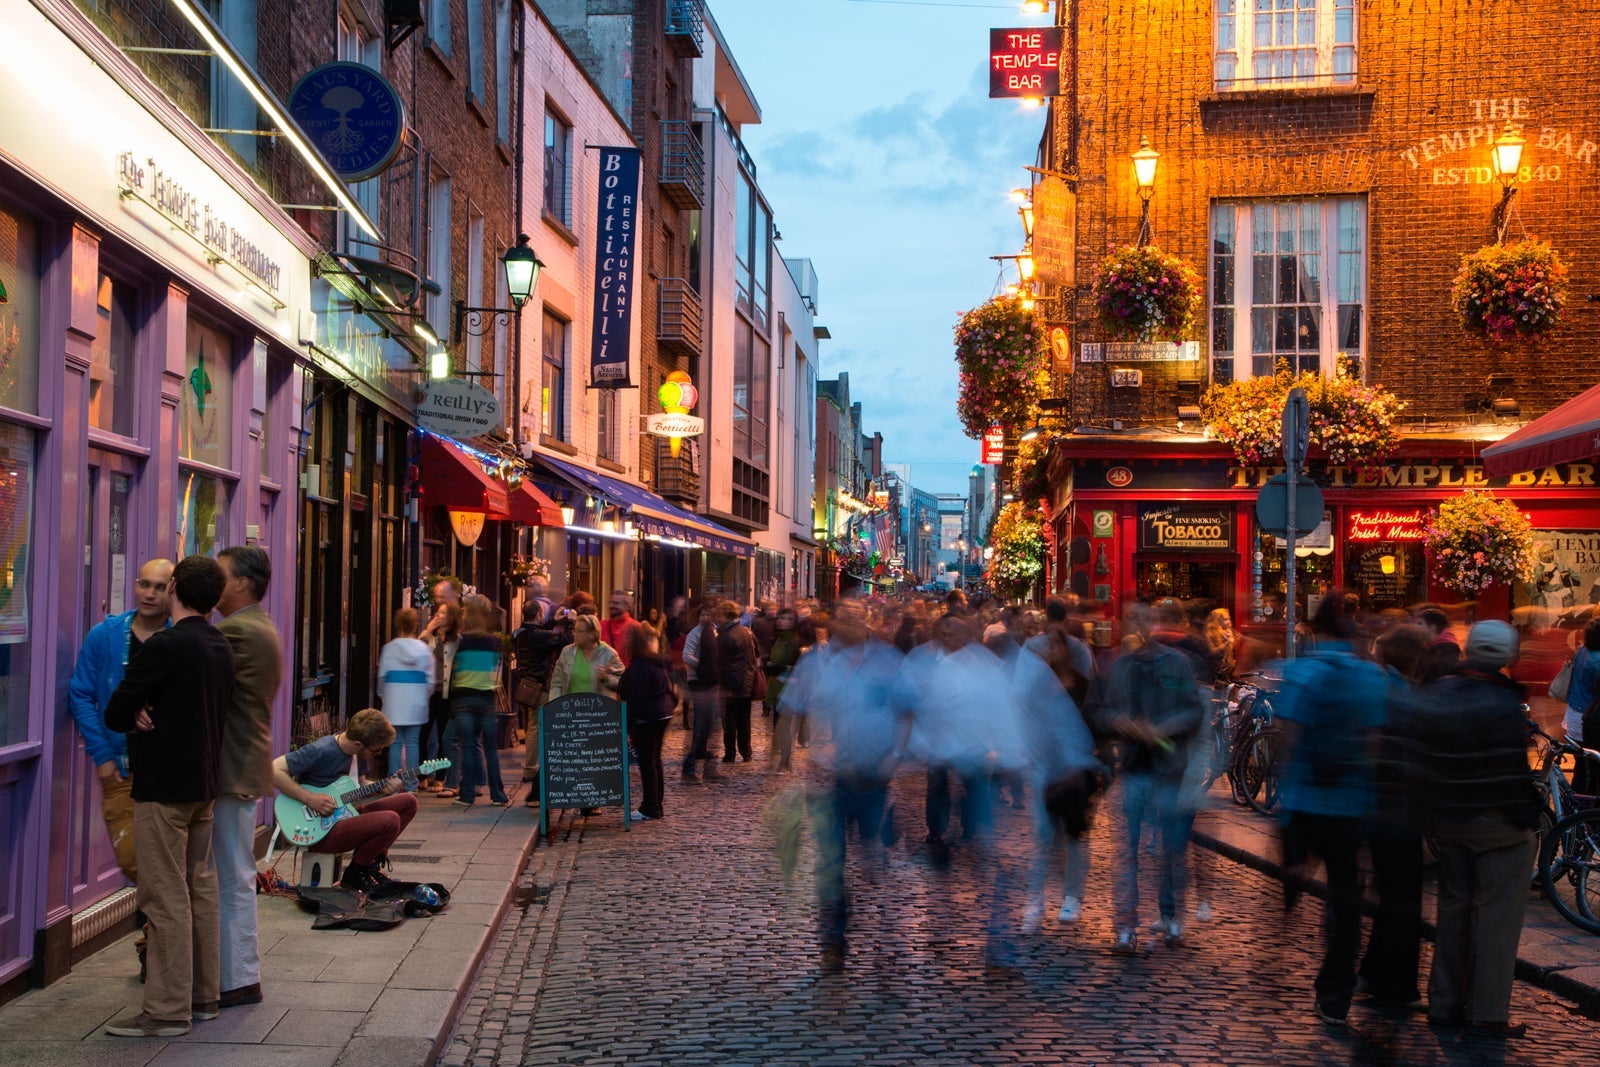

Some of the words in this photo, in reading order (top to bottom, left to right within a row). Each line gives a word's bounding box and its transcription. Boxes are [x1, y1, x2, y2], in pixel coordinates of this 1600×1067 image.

[1008, 34, 1041, 48] THE
[992, 53, 1057, 69] TEMPLE
[1008, 74, 1041, 88] BAR
[354, 73, 391, 114] YARD
[1470, 98, 1530, 120] THE
[1536, 125, 1597, 164] BAR
[1508, 165, 1561, 184] 840
[231, 227, 281, 292] PHARMACY
[600, 154, 621, 358] Botticelli
[617, 195, 631, 319] RESTAURANT
[1106, 352, 1132, 360] TEMPLE
[1134, 352, 1154, 360] LANE
[1155, 351, 1181, 359] SOUTH
[600, 365, 622, 373] Nastro
[418, 409, 455, 421] TRADITIONAL
[455, 415, 471, 424] IRISH
[472, 417, 488, 426] FOOD
[654, 421, 700, 433] Botticelli
[1111, 470, 1127, 482] 48
[1326, 464, 1489, 487] TEMPLE
[1509, 464, 1596, 486] BAR
[1351, 510, 1420, 525] Traditional
[1152, 521, 1221, 544] TOBACCO
[1349, 525, 1380, 539] Irish
[1387, 525, 1423, 539] Music
[1361, 547, 1393, 560] TEMPLE
[1575, 551, 1600, 564] BA
